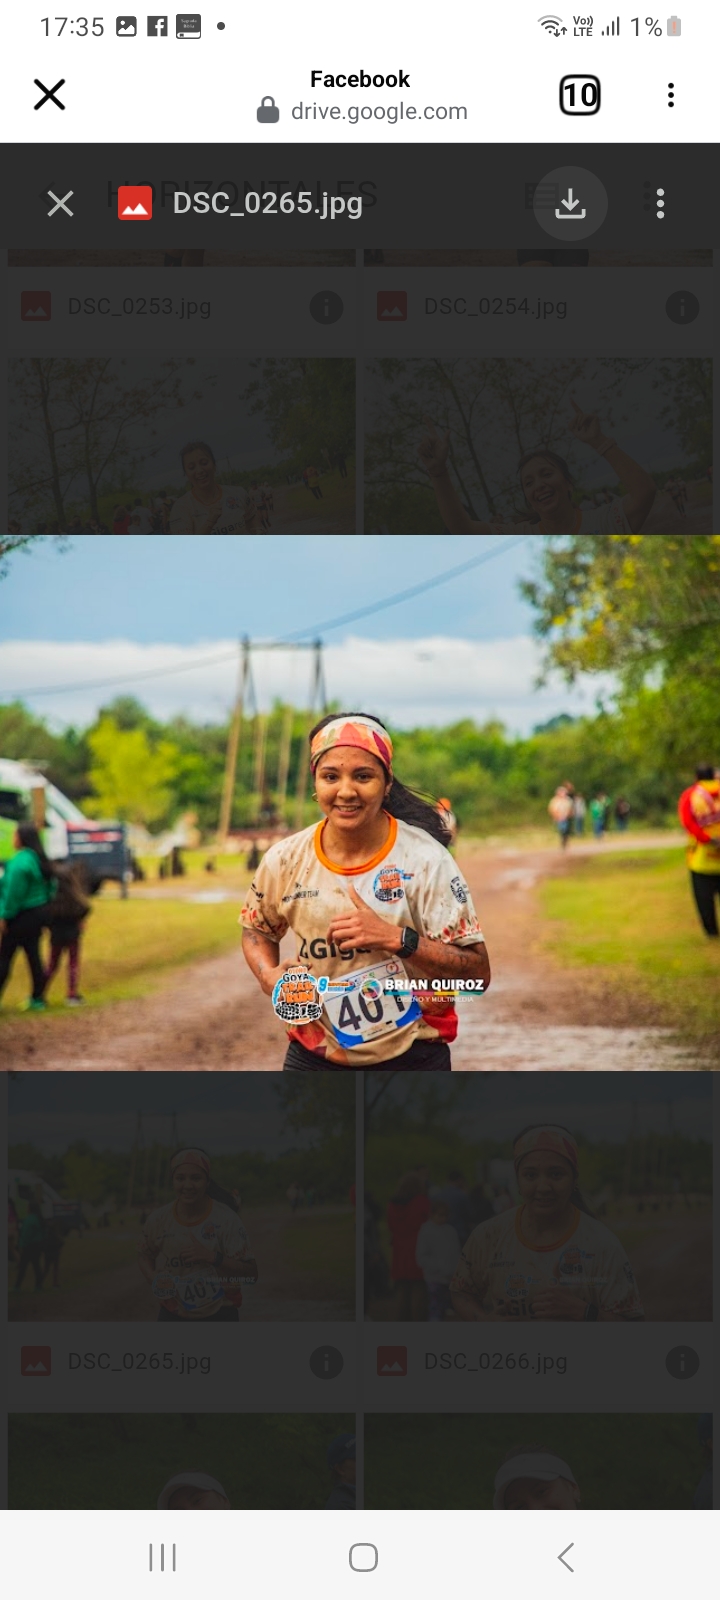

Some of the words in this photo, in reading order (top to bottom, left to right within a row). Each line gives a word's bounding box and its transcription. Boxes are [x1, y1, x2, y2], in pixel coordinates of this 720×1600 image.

[41, 17, 104, 36] 17:35
[574, 27, 592, 36] LTE
[631, 17, 662, 36] 1%
[311, 70, 410, 87] Facebook
[565, 84, 598, 106] 10
[292, 102, 468, 124] drive.google.com
[174, 191, 363, 220] DSC_0265.jpg
[68, 297, 211, 320] DSC_0253.jpg
[424, 297, 567, 320] DSC_0254.jpg
[337, 978, 406, 1031] 401
[68, 1352, 211, 1375] DSC_0265.jpg
[424, 1352, 567, 1375] DSC_0266.jpg
